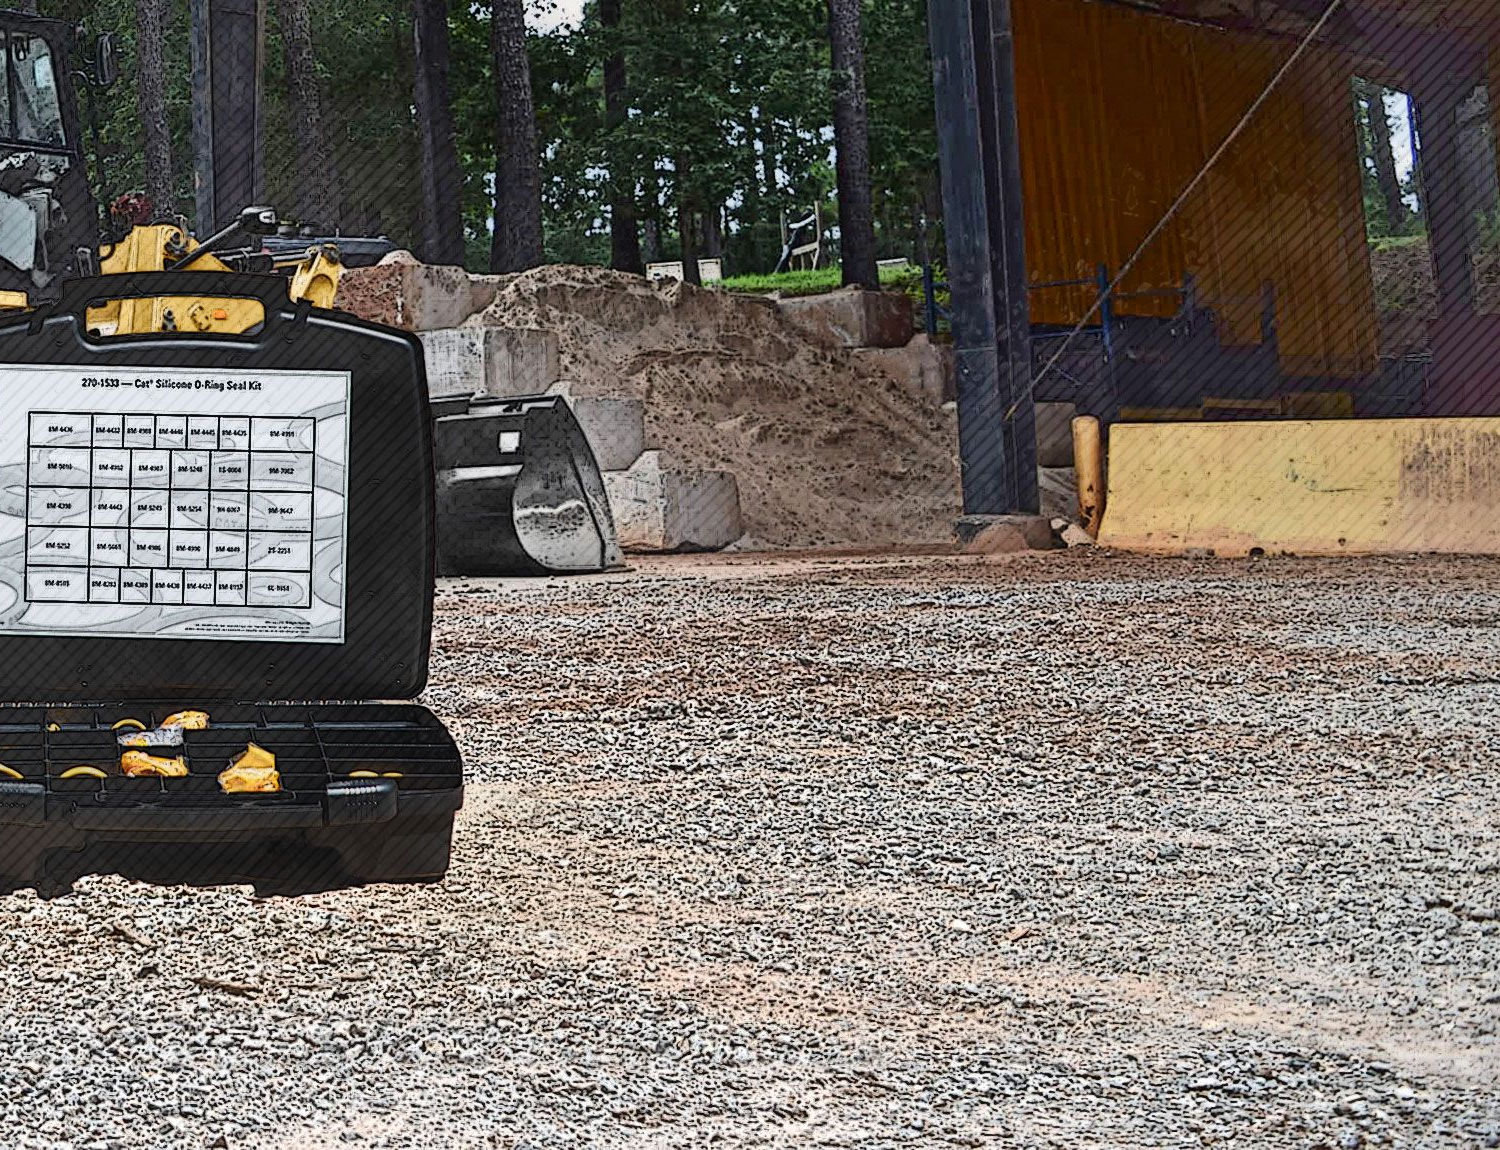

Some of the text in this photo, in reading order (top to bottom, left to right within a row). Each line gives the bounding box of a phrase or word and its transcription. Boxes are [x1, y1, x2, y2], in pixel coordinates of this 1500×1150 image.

[81, 378, 120, 388] 270-1533
[155, 378, 193, 390] Silicone
[194, 380, 224, 392] O-Ring
[226, 380, 247, 391] Seal
[249, 381, 262, 391] Kit
